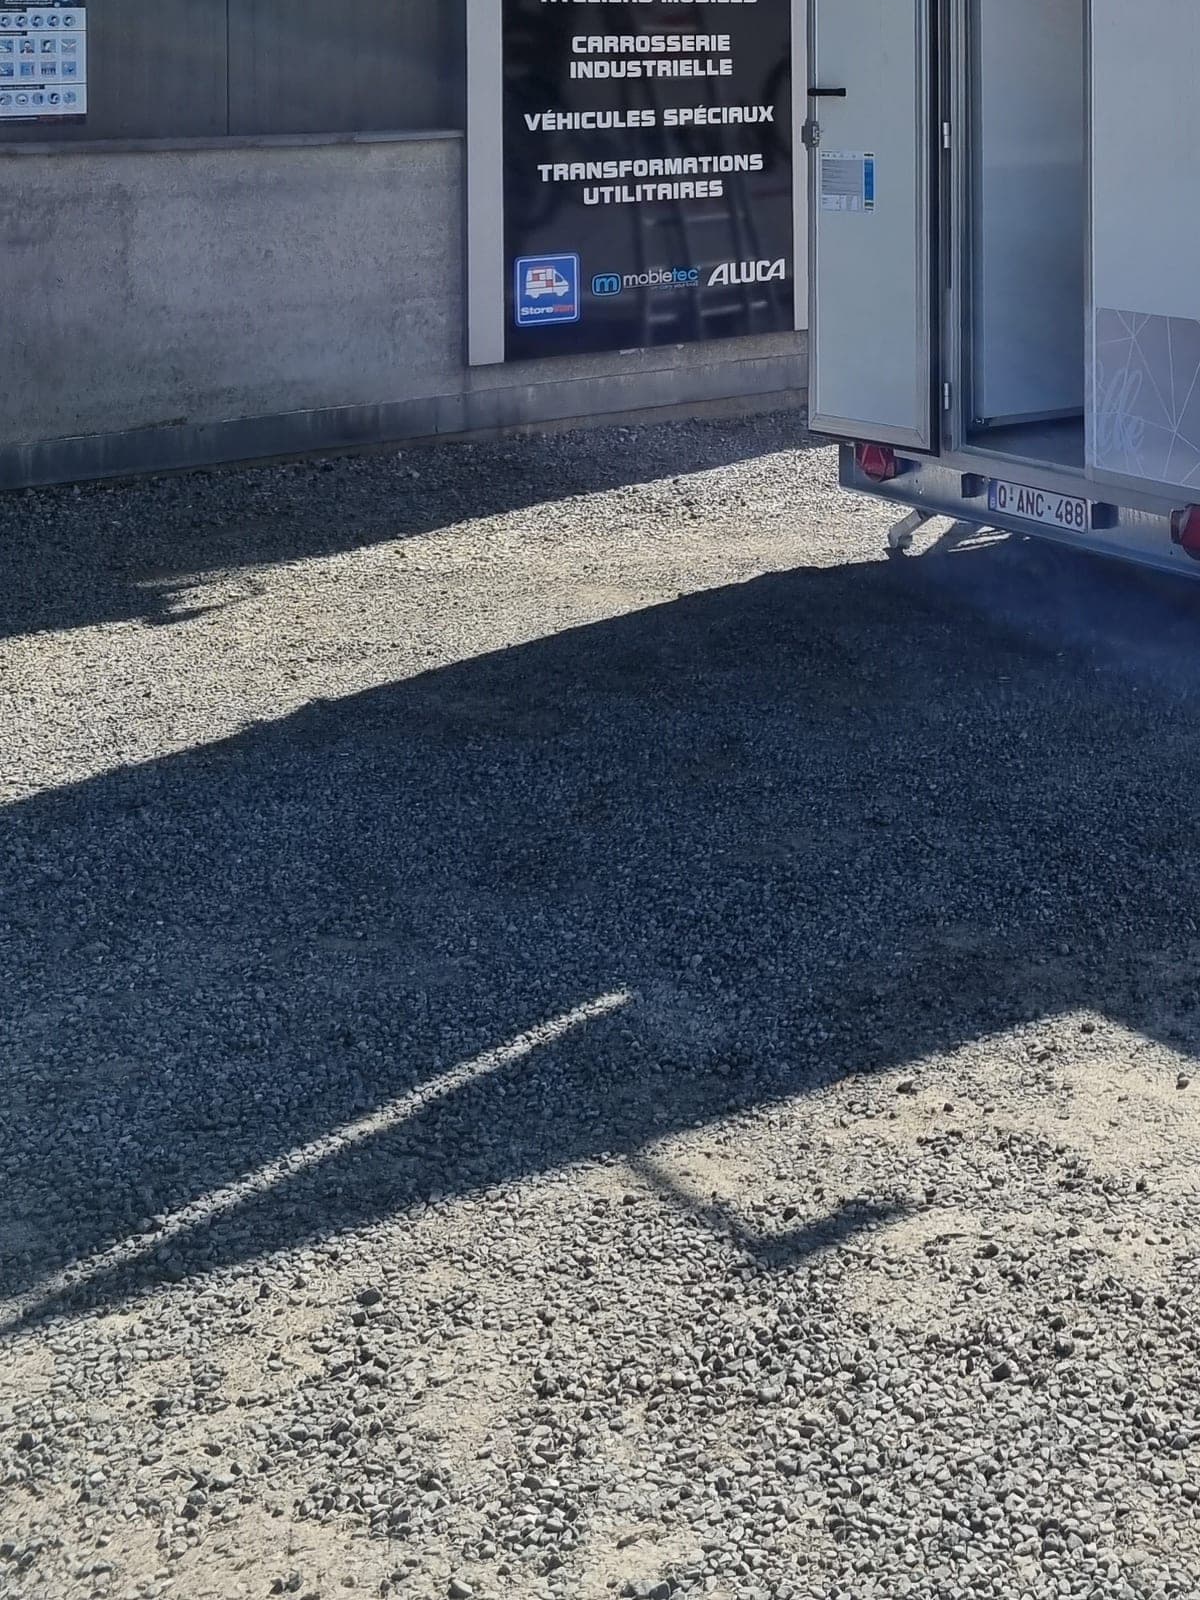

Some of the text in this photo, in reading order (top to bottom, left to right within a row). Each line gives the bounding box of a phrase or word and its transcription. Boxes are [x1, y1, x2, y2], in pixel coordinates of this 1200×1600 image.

[571, 34, 731, 53] CARROSSERIE
[569, 58, 734, 79] INDUSTRIELLE
[523, 104, 774, 132] VÉHICULES SPÉCIAUX
[537, 153, 764, 182] TRANSFORMATIONS
[583, 179, 724, 206] UTILITAIRES
[707, 258, 785, 287] ALUCA
